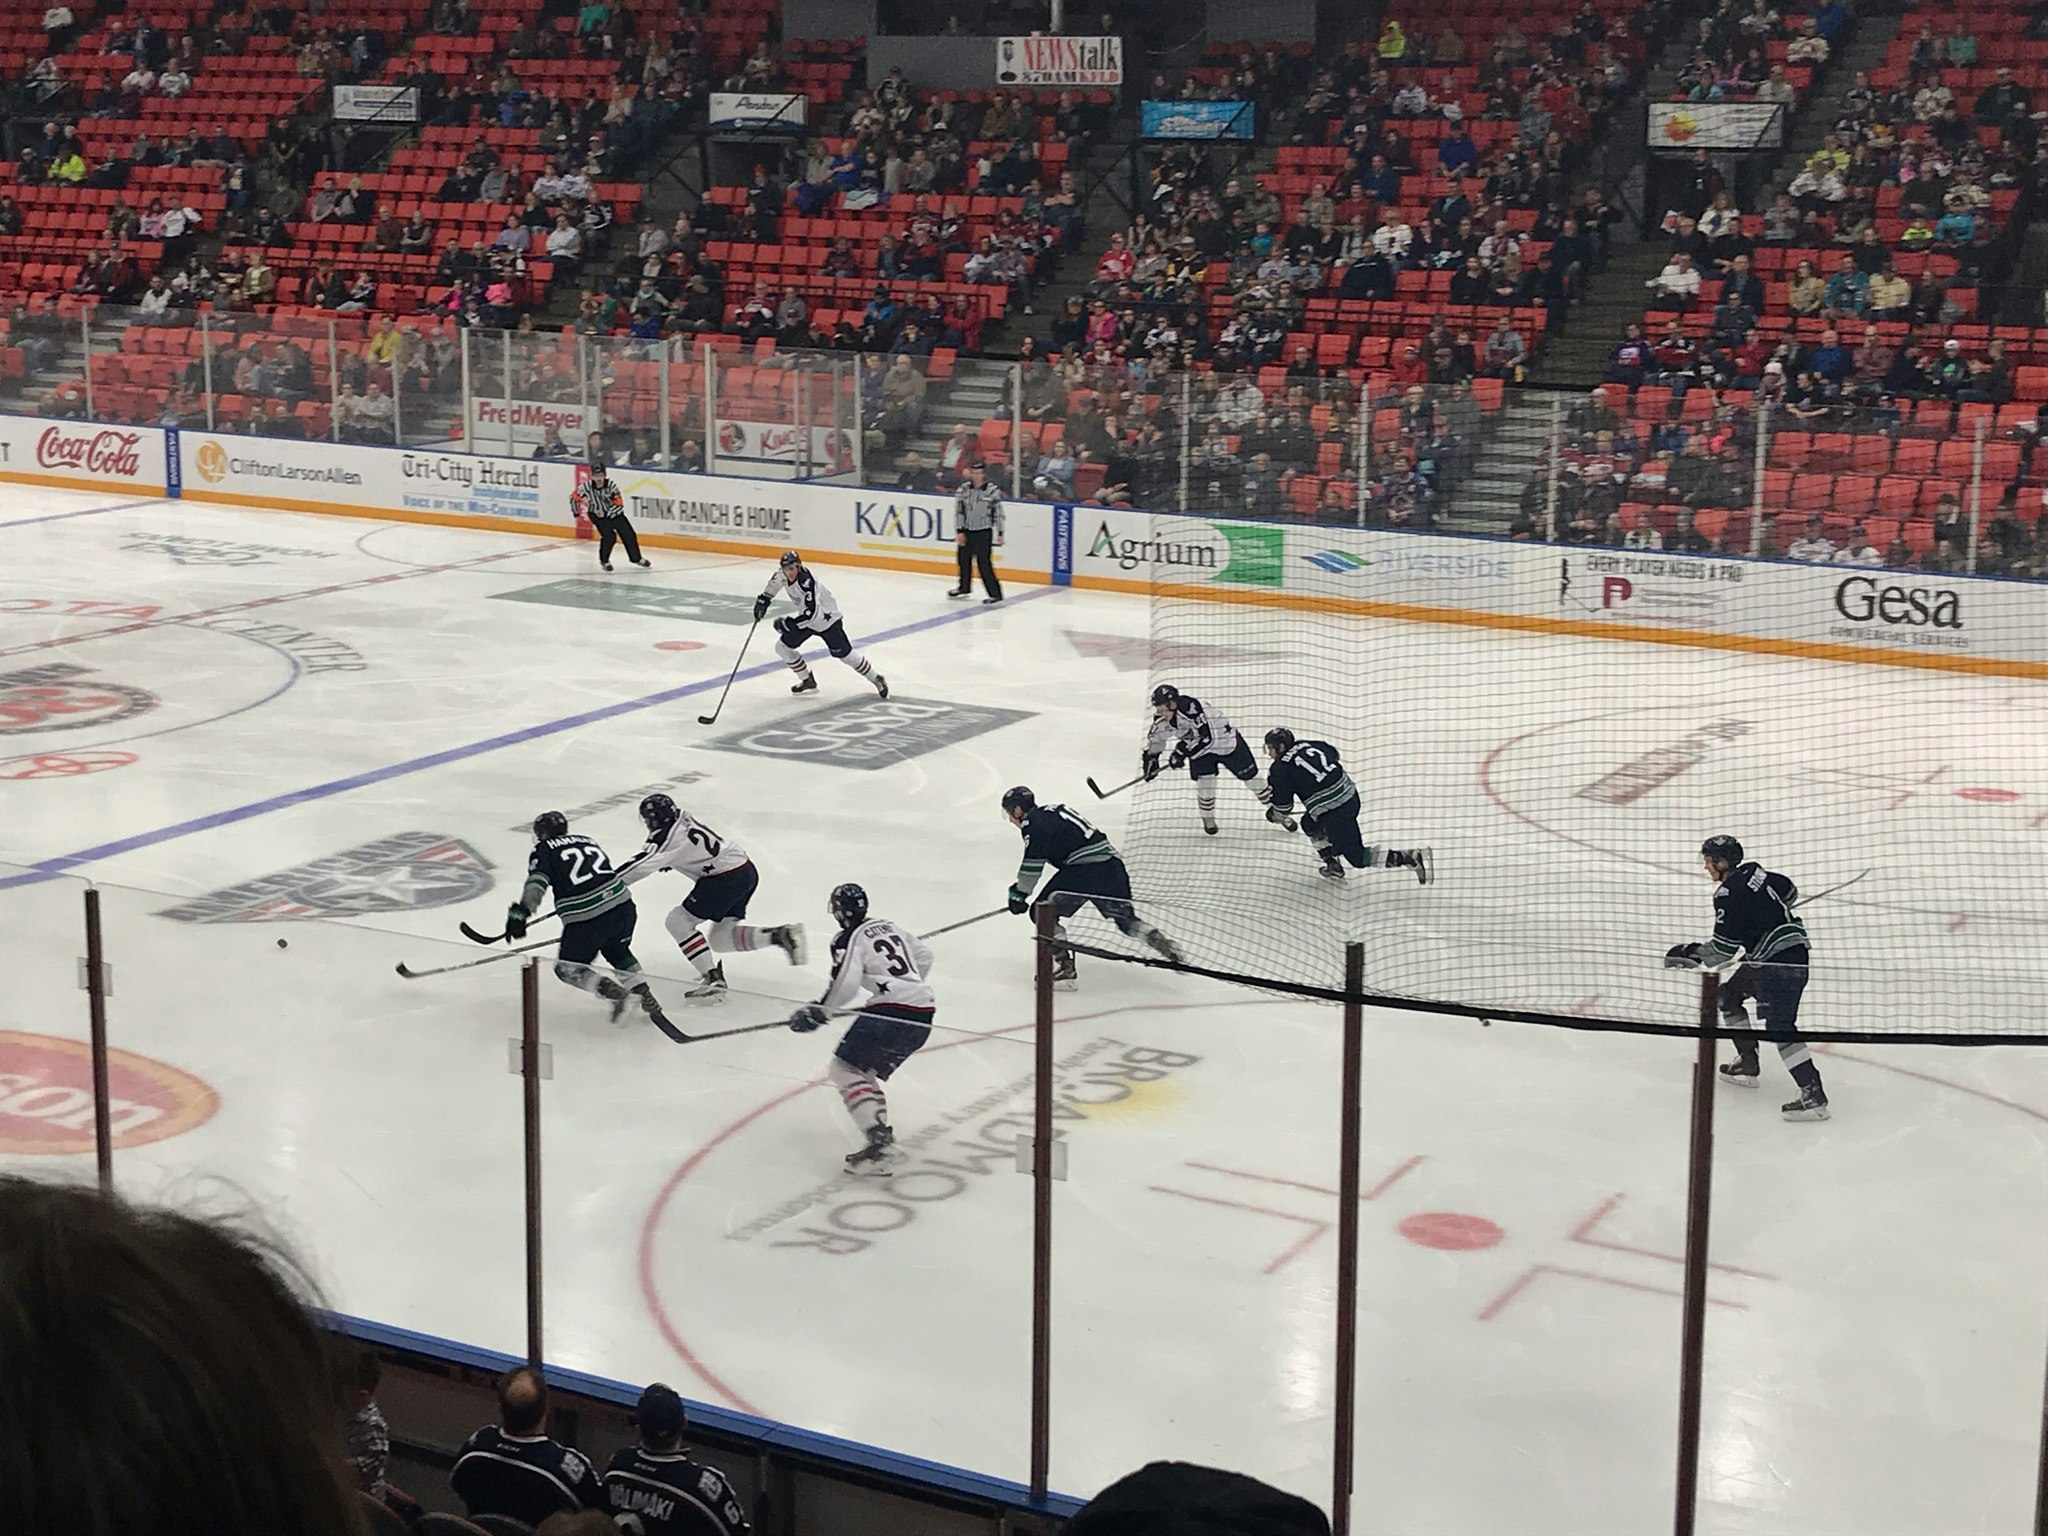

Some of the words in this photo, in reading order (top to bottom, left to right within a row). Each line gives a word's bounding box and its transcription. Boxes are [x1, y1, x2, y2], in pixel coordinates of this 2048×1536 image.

[37, 426, 142, 476] Coca-Cola
[230, 457, 363, 485] CliftonLarsonAllen
[401, 454, 473, 488] Tri-City
[477, 460, 540, 489] Herald
[631, 496, 676, 521] THINK
[679, 501, 729, 526] RANCH
[733, 505, 744, 527] &
[746, 506, 792, 531] HOME
[855, 501, 960, 543] KADL
[1086, 520, 1218, 570] Agrium
[1382, 551, 1511, 579] RIVERSIDE
[1835, 576, 1964, 629] Gesa
[202, 618, 368, 676] CENTER
[738, 702, 955, 754] Gesa
[1294, 747, 1337, 783] 12
[509, 783, 676, 834] PSENTED
[560, 847, 615, 885] 22
[769, 1045, 1202, 1255] BROADMOOR
